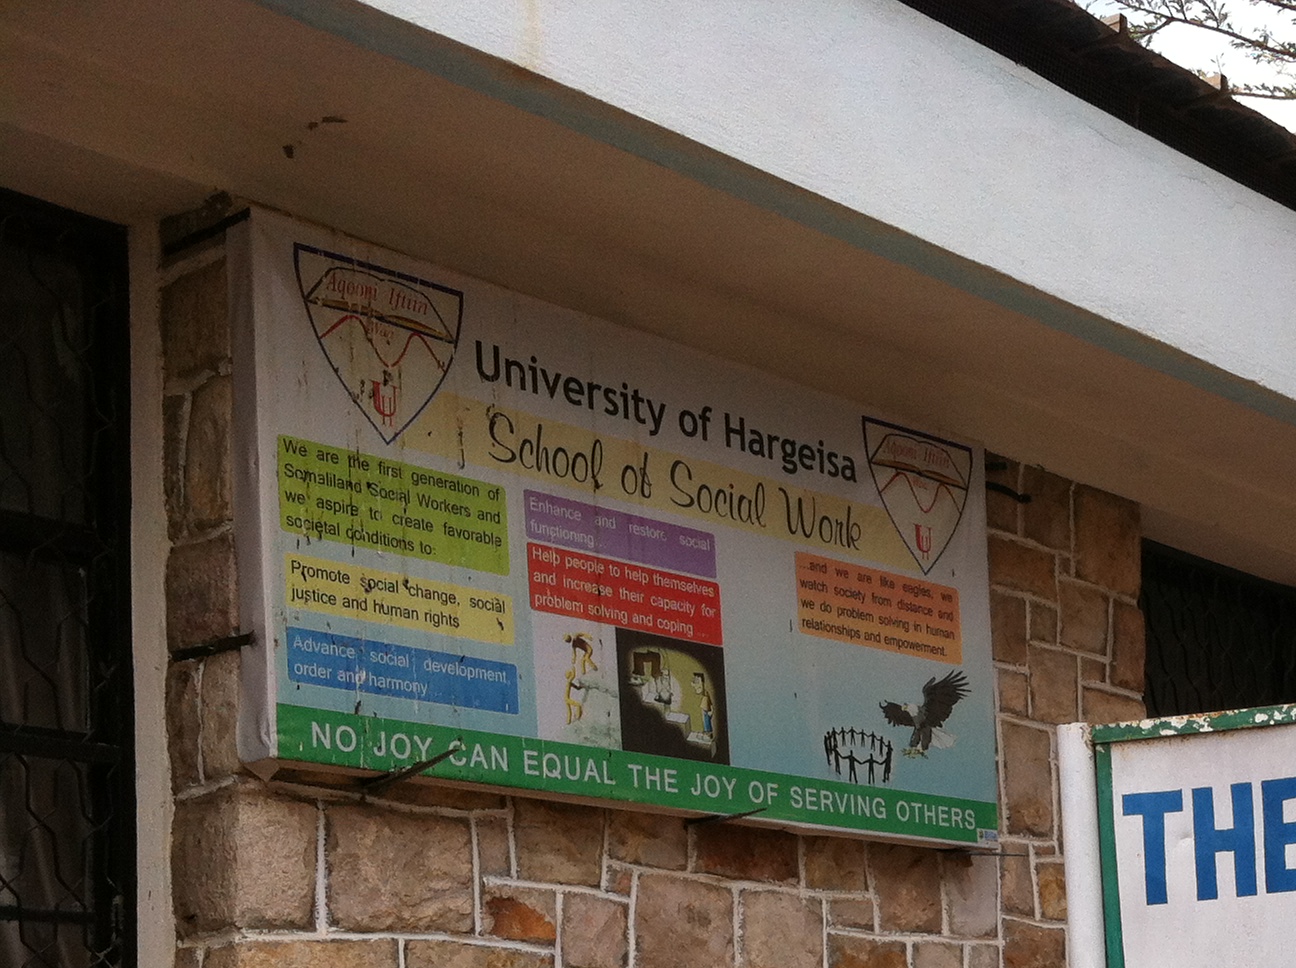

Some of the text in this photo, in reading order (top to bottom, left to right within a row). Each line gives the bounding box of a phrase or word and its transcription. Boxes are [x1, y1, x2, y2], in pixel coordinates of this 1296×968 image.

[476, 340, 665, 437] University
[678, 406, 711, 441] of
[724, 412, 857, 483] Hargeisa
[283, 438, 500, 501] We are the first generation of
[487, 411, 861, 551] School of Social Work
[284, 463, 500, 524] Somaliland Social Workers and
[285, 490, 502, 547] we aspire to create favorable
[286, 515, 340, 537] societal
[346, 527, 415, 551] conditions
[530, 496, 710, 551] Enhance and restore social
[291, 560, 506, 614] Promote social change, social
[532, 547, 715, 598] Help people to help themselves
[533, 570, 716, 617] and increase their capacity for
[835, 567, 849, 578] we
[857, 572, 872, 585] are
[880, 576, 895, 590] like
[941, 592, 953, 603] we
[291, 587, 460, 628] justice and human rights
[535, 593, 584, 613] problem
[588, 604, 628, 624] solving
[632, 613, 653, 627] and
[657, 618, 694, 638] coping
[800, 579, 954, 622] watch society from distance and
[801, 598, 955, 640] we do problem solving in human
[293, 636, 355, 659] Advance
[370, 650, 409, 669] social
[802, 618, 861, 640] relationships
[864, 630, 881, 644] and
[294, 662, 332, 680] order
[338, 669, 366, 685] and
[312, 722, 976, 830] NO JOY CAN EQUAL THE JOY OF SERVING OTHERS
